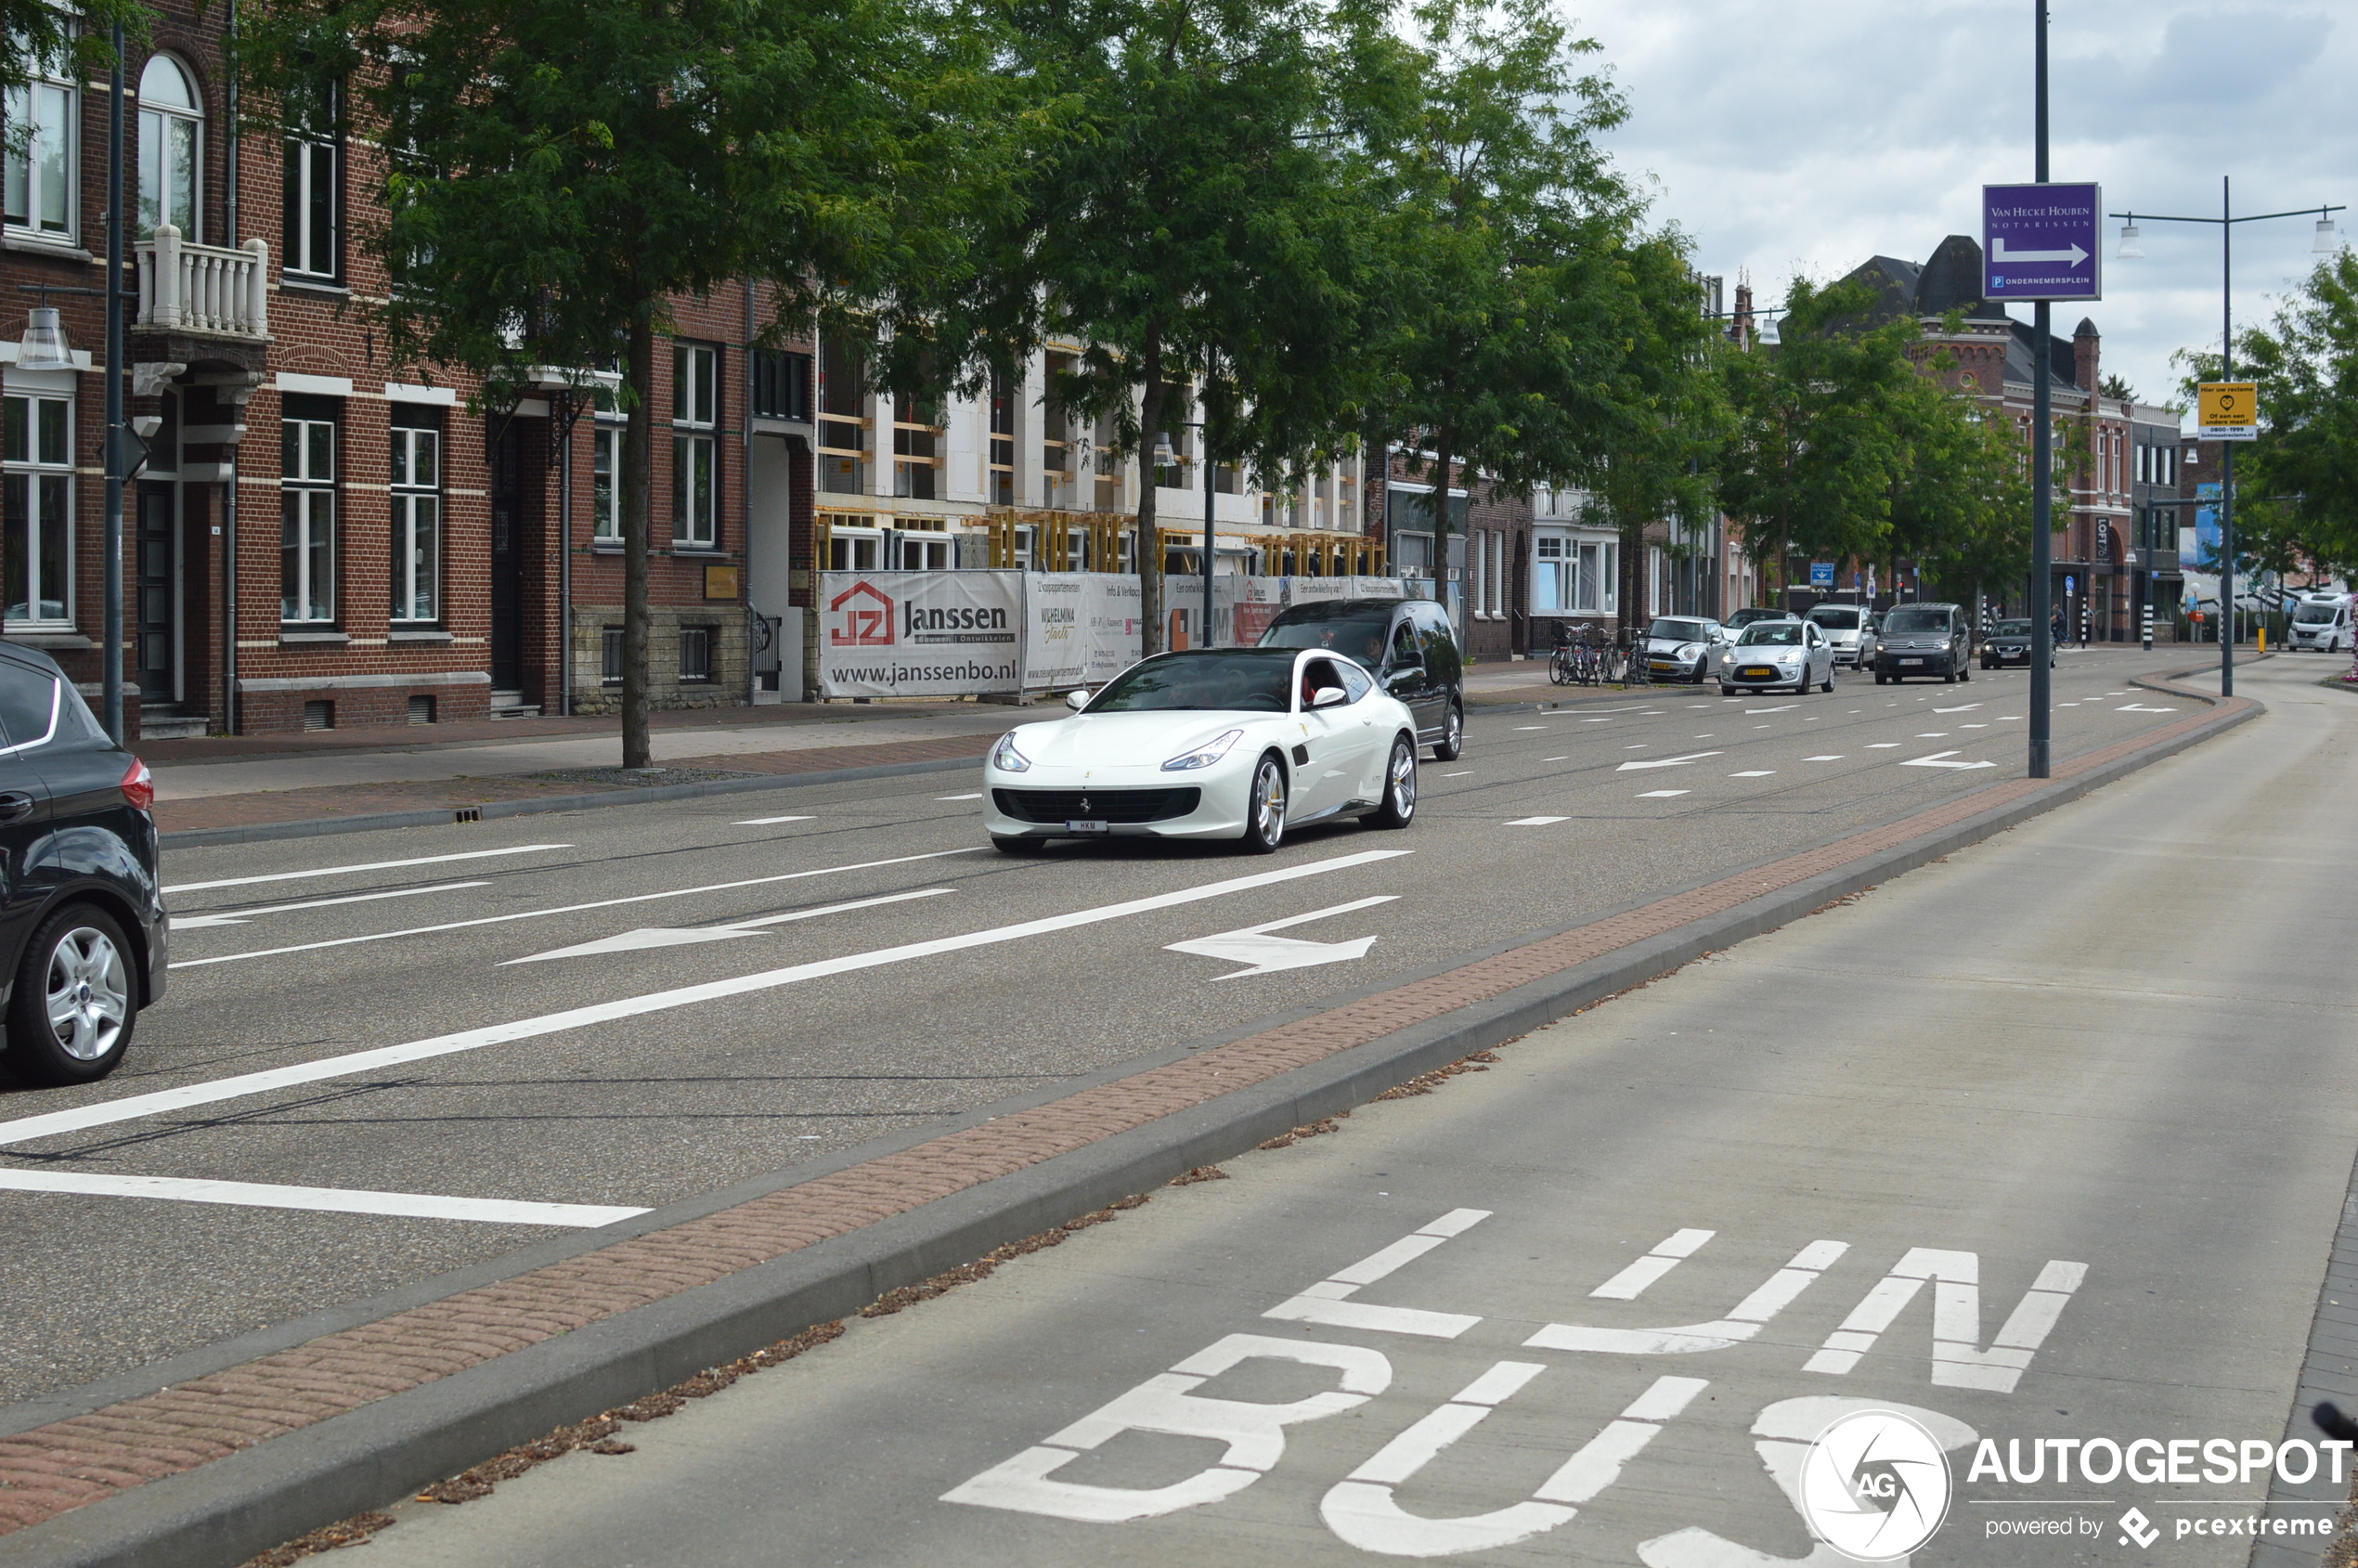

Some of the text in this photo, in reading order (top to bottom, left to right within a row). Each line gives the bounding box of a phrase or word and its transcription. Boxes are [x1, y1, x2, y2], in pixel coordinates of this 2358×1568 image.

[1991, 206, 2090, 217] VAN HECKE HOUBEN
[1991, 220, 2090, 229] NOTARISSEN
[2005, 277, 2090, 285] ONDERNEMERSPLEIN
[1106, 585, 1116, 597] Info
[903, 600, 1007, 639] Janssen
[960, 634, 1012, 642] Ontwikkelen
[832, 659, 1017, 687] www.janssenbo.nl
[1080, 822, 1095, 830] HKM
[938, 1332, 1979, 1568] BUS
